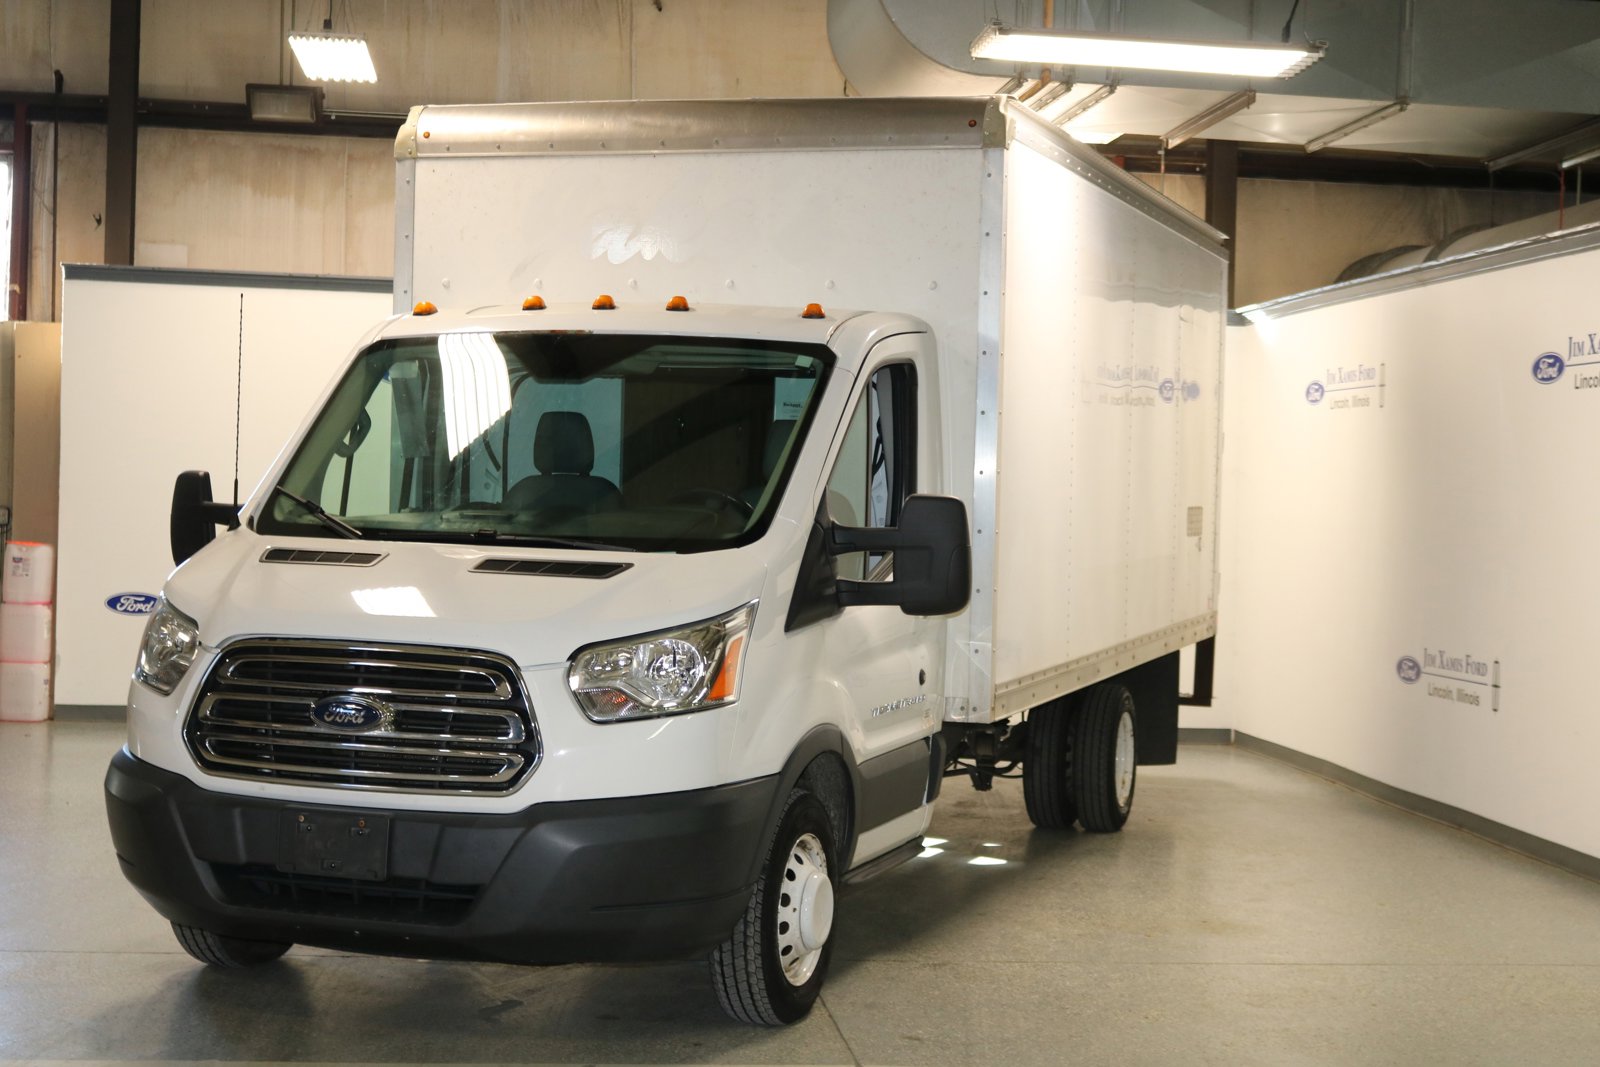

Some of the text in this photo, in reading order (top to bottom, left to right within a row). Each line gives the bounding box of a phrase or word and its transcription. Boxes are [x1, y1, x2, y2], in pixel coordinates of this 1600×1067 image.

[1536, 357, 1560, 379] Ford
[116, 595, 154, 612] Ford
[323, 703, 366, 724] Ford
